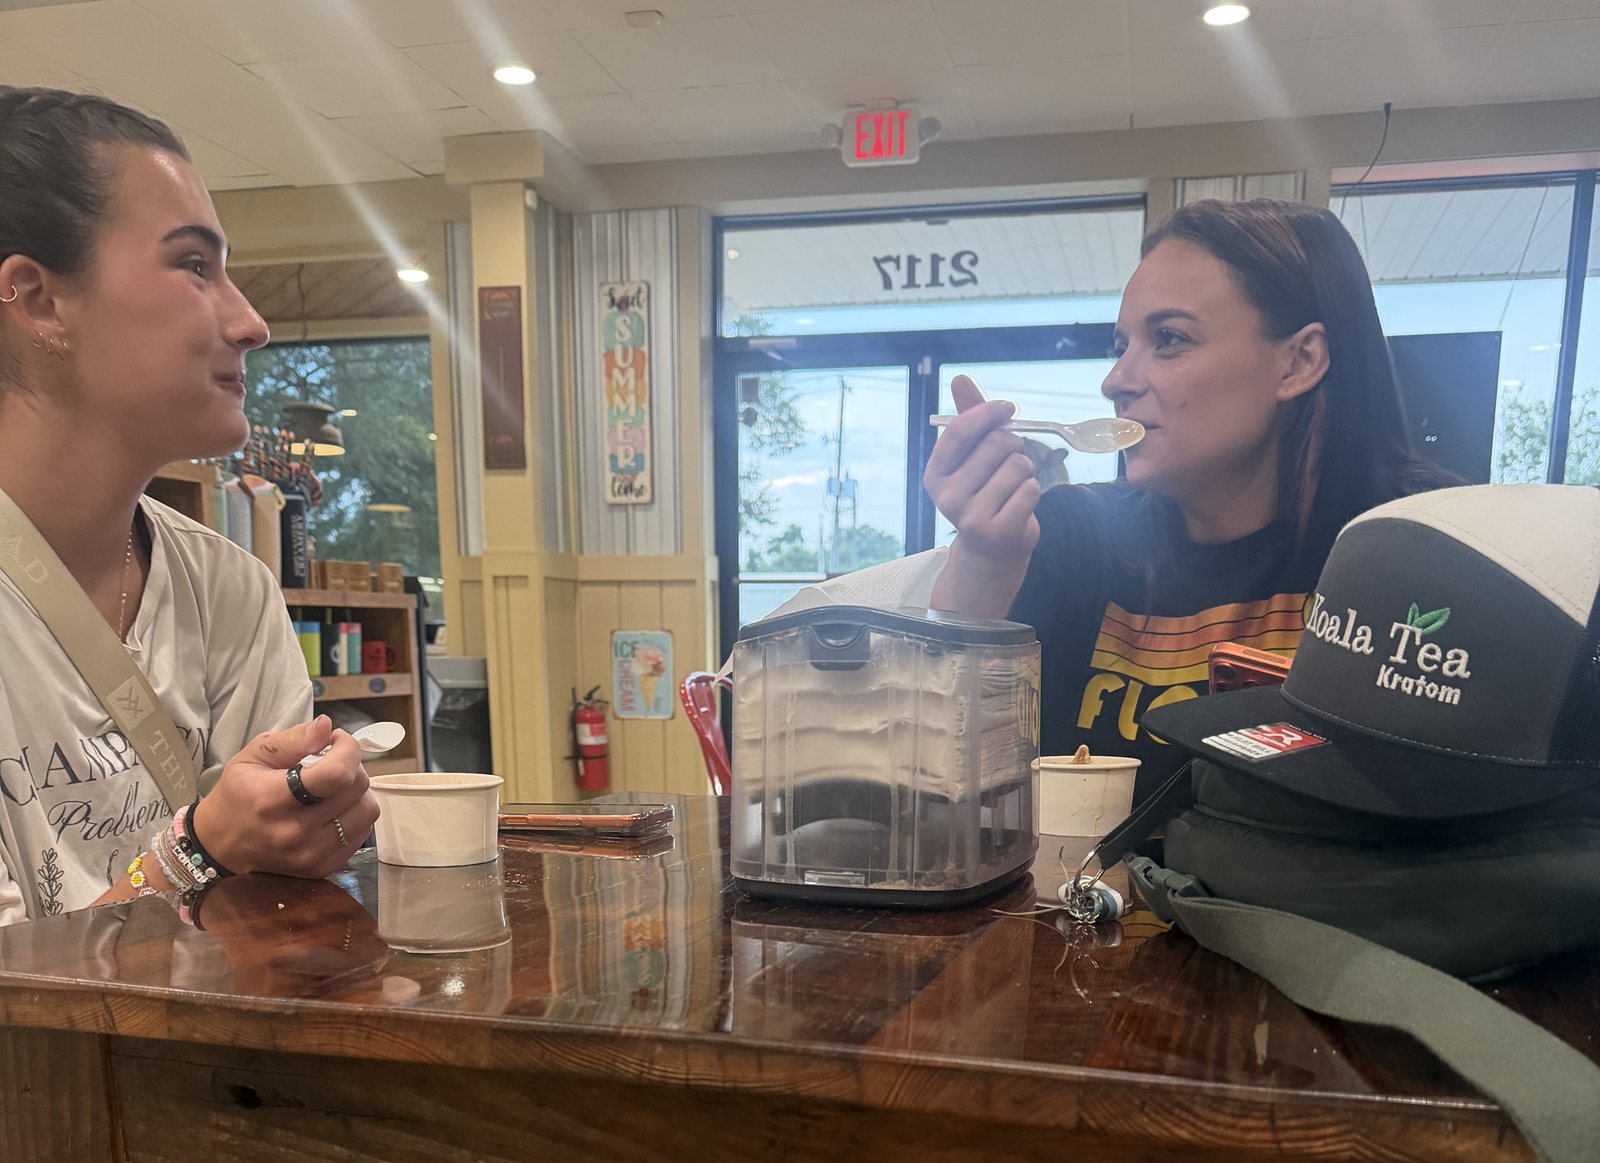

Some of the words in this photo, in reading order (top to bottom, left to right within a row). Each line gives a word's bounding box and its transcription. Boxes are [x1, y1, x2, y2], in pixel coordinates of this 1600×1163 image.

[855, 111, 909, 160] EXIT
[612, 315, 638, 469] SUMMER
[613, 641, 639, 659] ICE
[1306, 593, 1374, 655] Koala
[1389, 622, 1471, 679] Tea
[1376, 664, 1461, 705] Kratom
